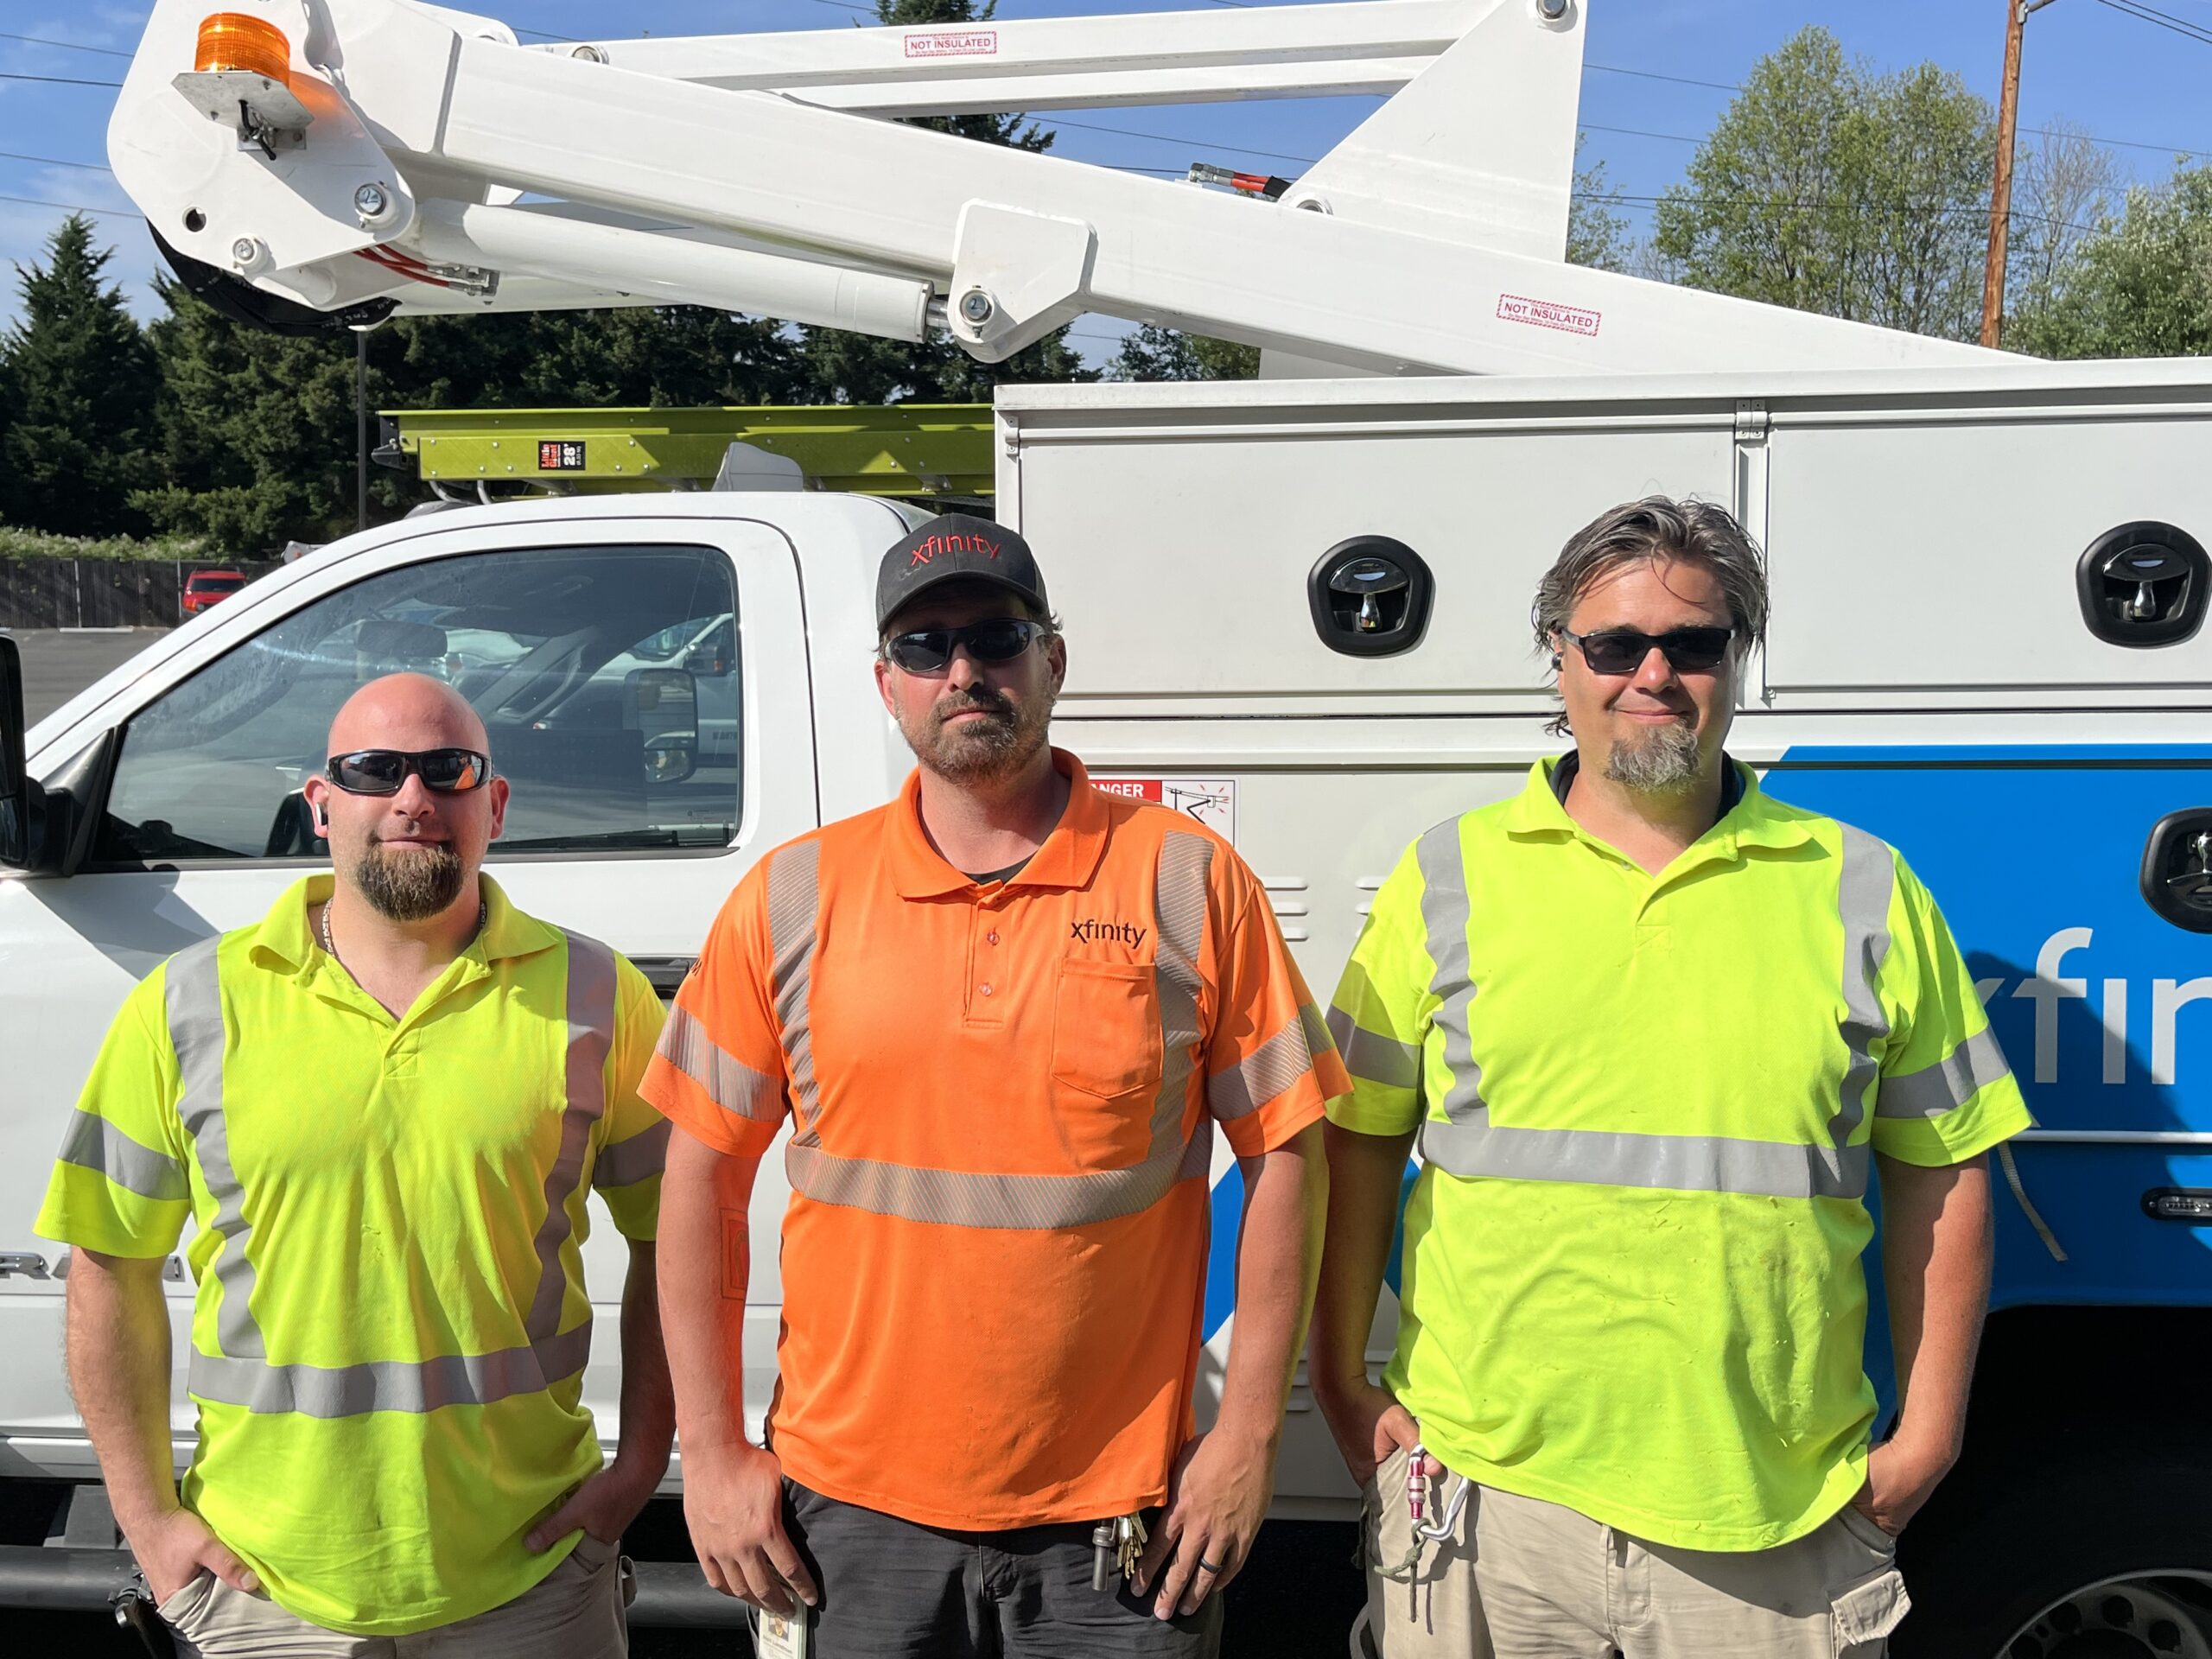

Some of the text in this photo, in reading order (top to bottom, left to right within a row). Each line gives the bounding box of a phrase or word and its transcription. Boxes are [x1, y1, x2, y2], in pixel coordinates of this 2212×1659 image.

[911, 38, 991, 50] NOT INSULATED
[970, 297, 982, 310] 2
[1504, 302, 1529, 315] NOT
[1530, 308, 1592, 327] INSULATED
[911, 533, 1002, 567] xfinity
[1071, 918, 1147, 950] xfinity
[1974, 926, 2212, 1085] fin
